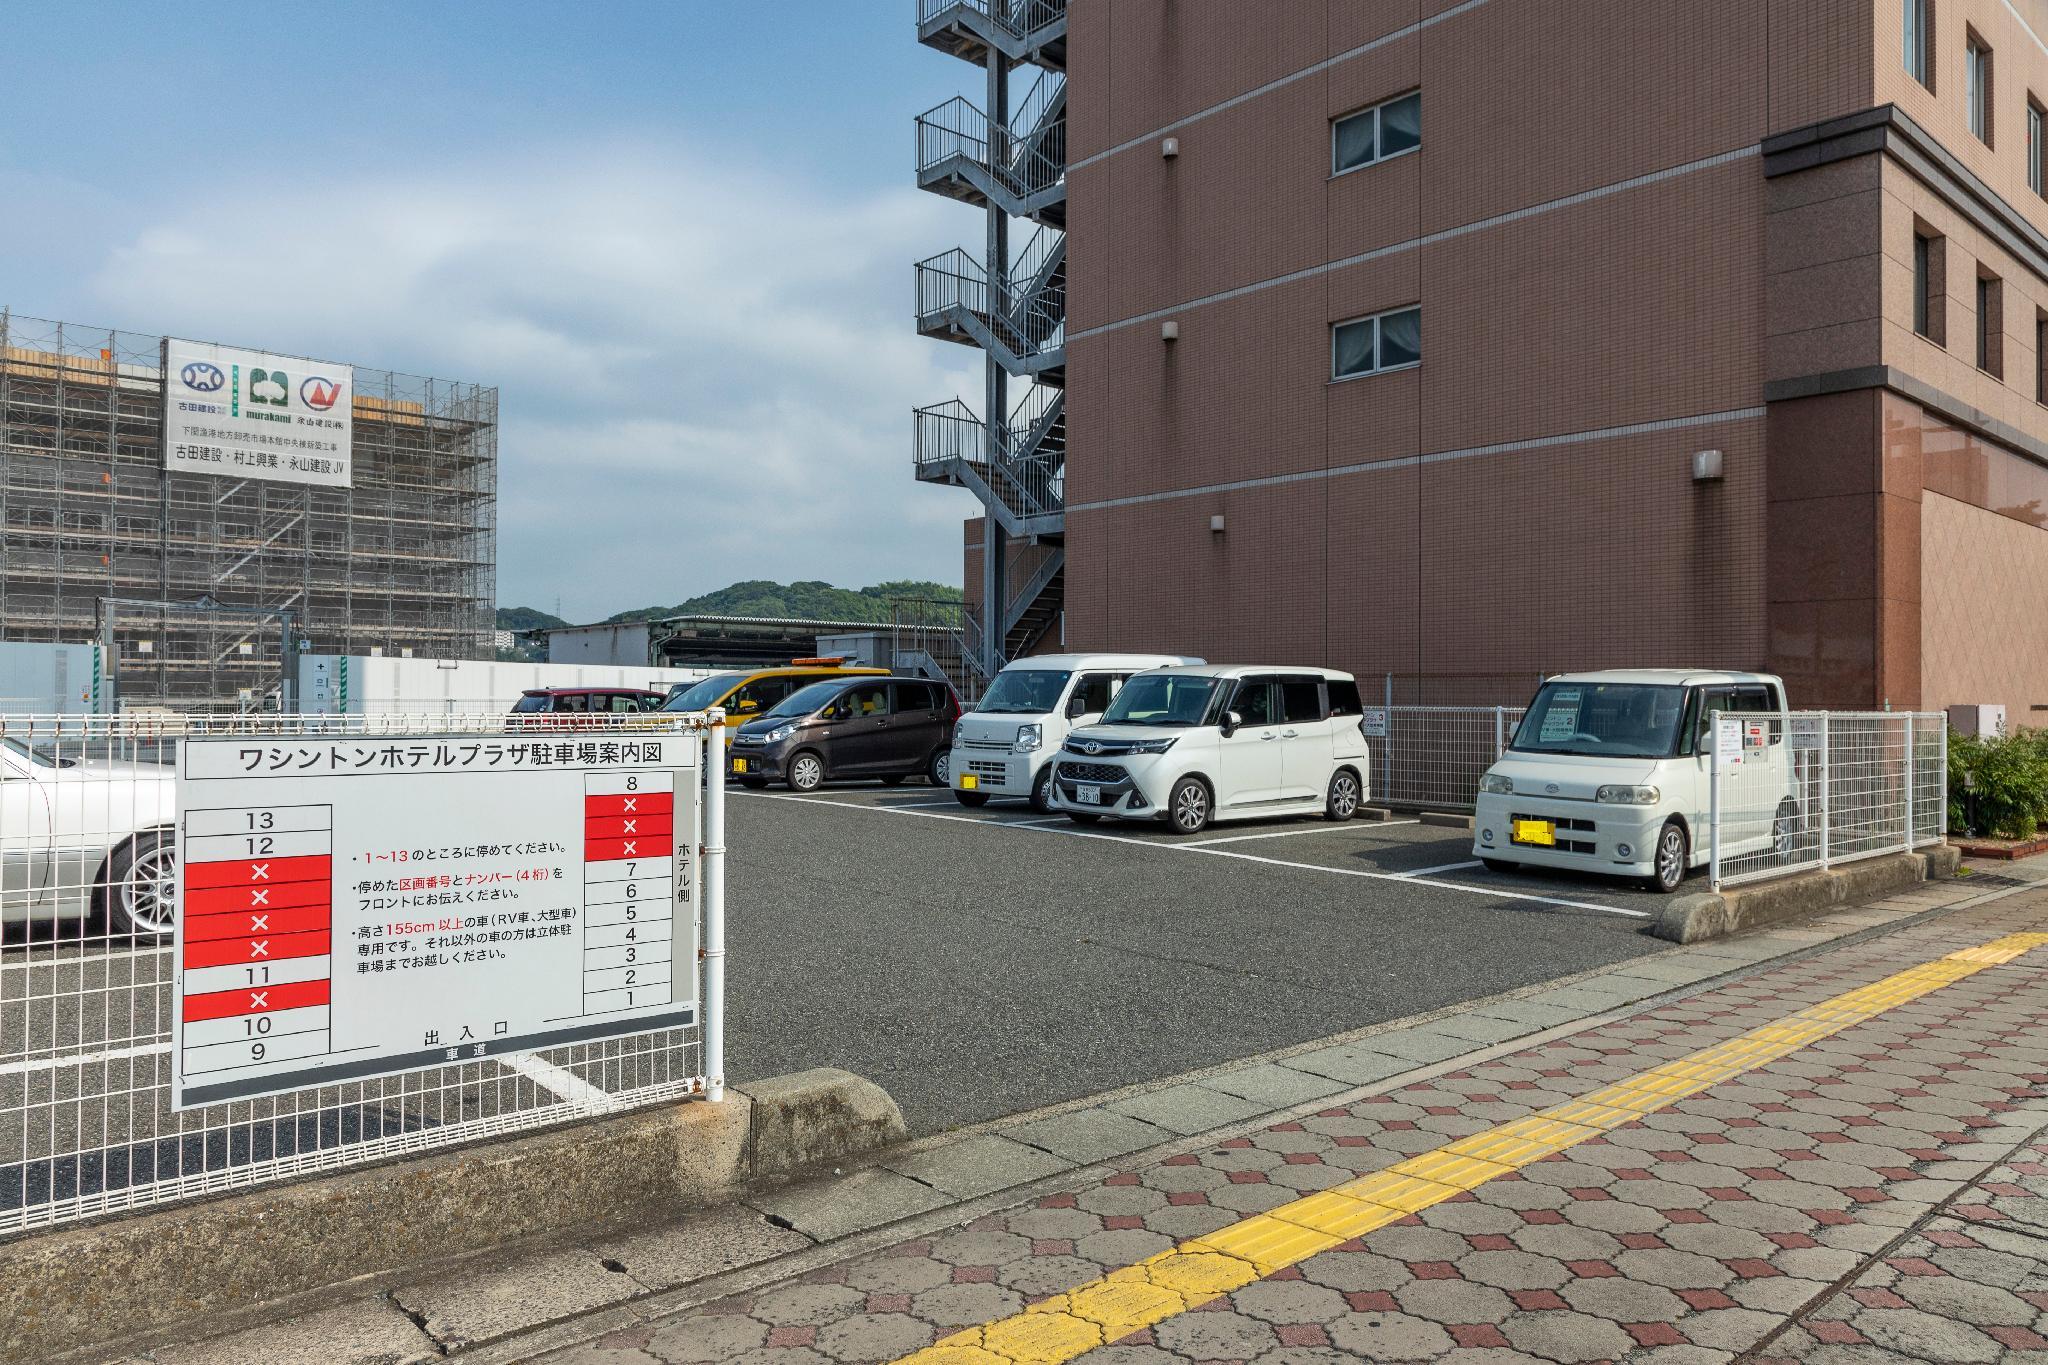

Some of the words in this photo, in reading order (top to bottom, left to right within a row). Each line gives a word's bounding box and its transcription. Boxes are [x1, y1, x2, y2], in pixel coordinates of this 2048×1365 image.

[246, 410, 292, 424] murakami
[334, 462, 344, 474] JV
[239, 741, 662, 772] ワシントンホテルプラザ駐車場案内図
[626, 776, 638, 791] 8
[246, 811, 274, 830] 13
[246, 837, 274, 855] 12
[626, 862, 637, 877] 7
[677, 843, 690, 903] ホテル側
[626, 883, 637, 899] 6
[359, 889, 519, 912] フロントにお伝えください。
[626, 905, 637, 920] 5
[357, 923, 572, 958] 専用です。それ以外の車の方は立体駐
[625, 927, 637, 941] 4
[357, 949, 507, 975] 車場までお越しください。
[626, 947, 636, 962] 3
[245, 966, 270, 985] 11
[625, 969, 637, 985] 2
[626, 991, 634, 1006] 1
[244, 1016, 272, 1036] 10
[251, 1042, 266, 1061] 9
